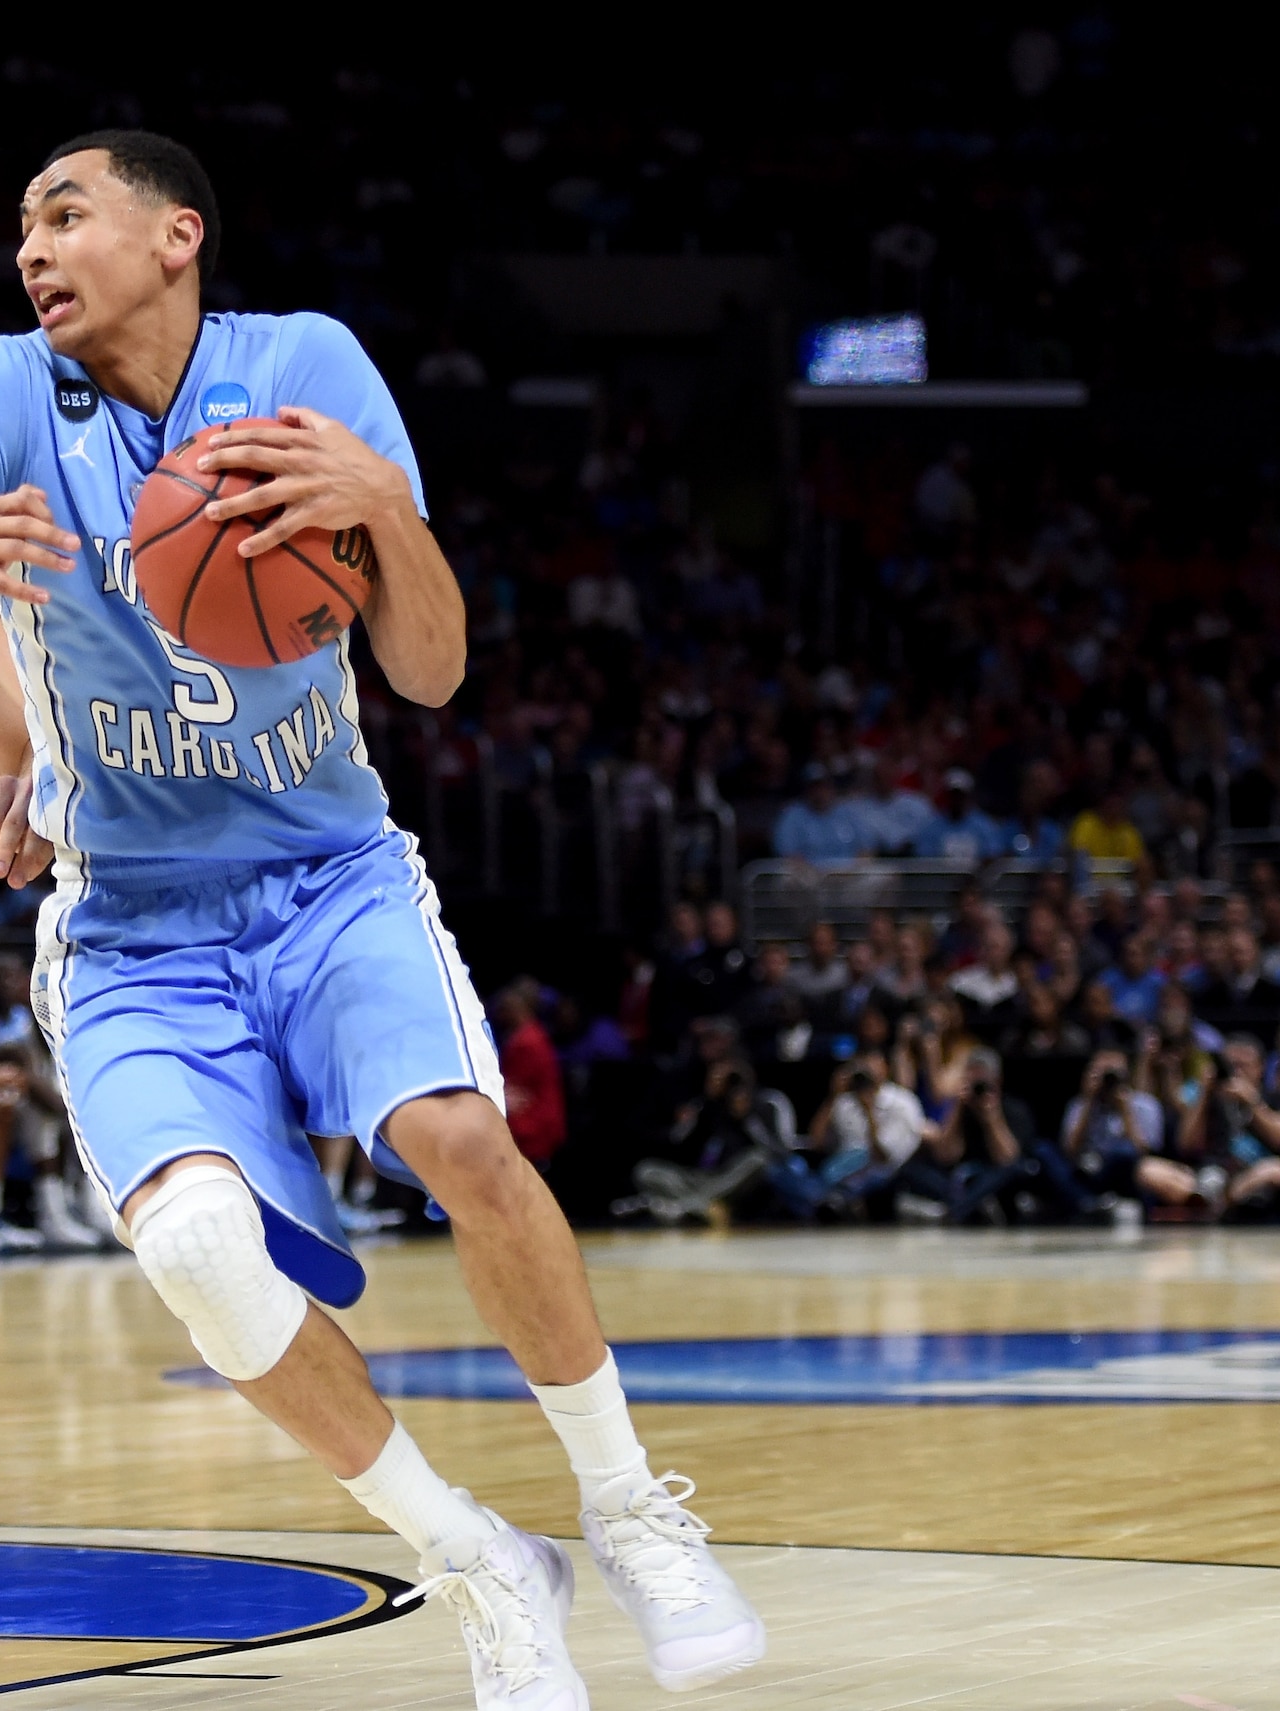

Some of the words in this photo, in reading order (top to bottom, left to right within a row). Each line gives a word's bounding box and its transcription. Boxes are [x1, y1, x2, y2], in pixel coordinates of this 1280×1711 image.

[60, 391, 91, 407] DES
[207, 402, 248, 417] NCAA
[142, 614, 238, 725] 5
[90, 685, 336, 795] CAROINA
